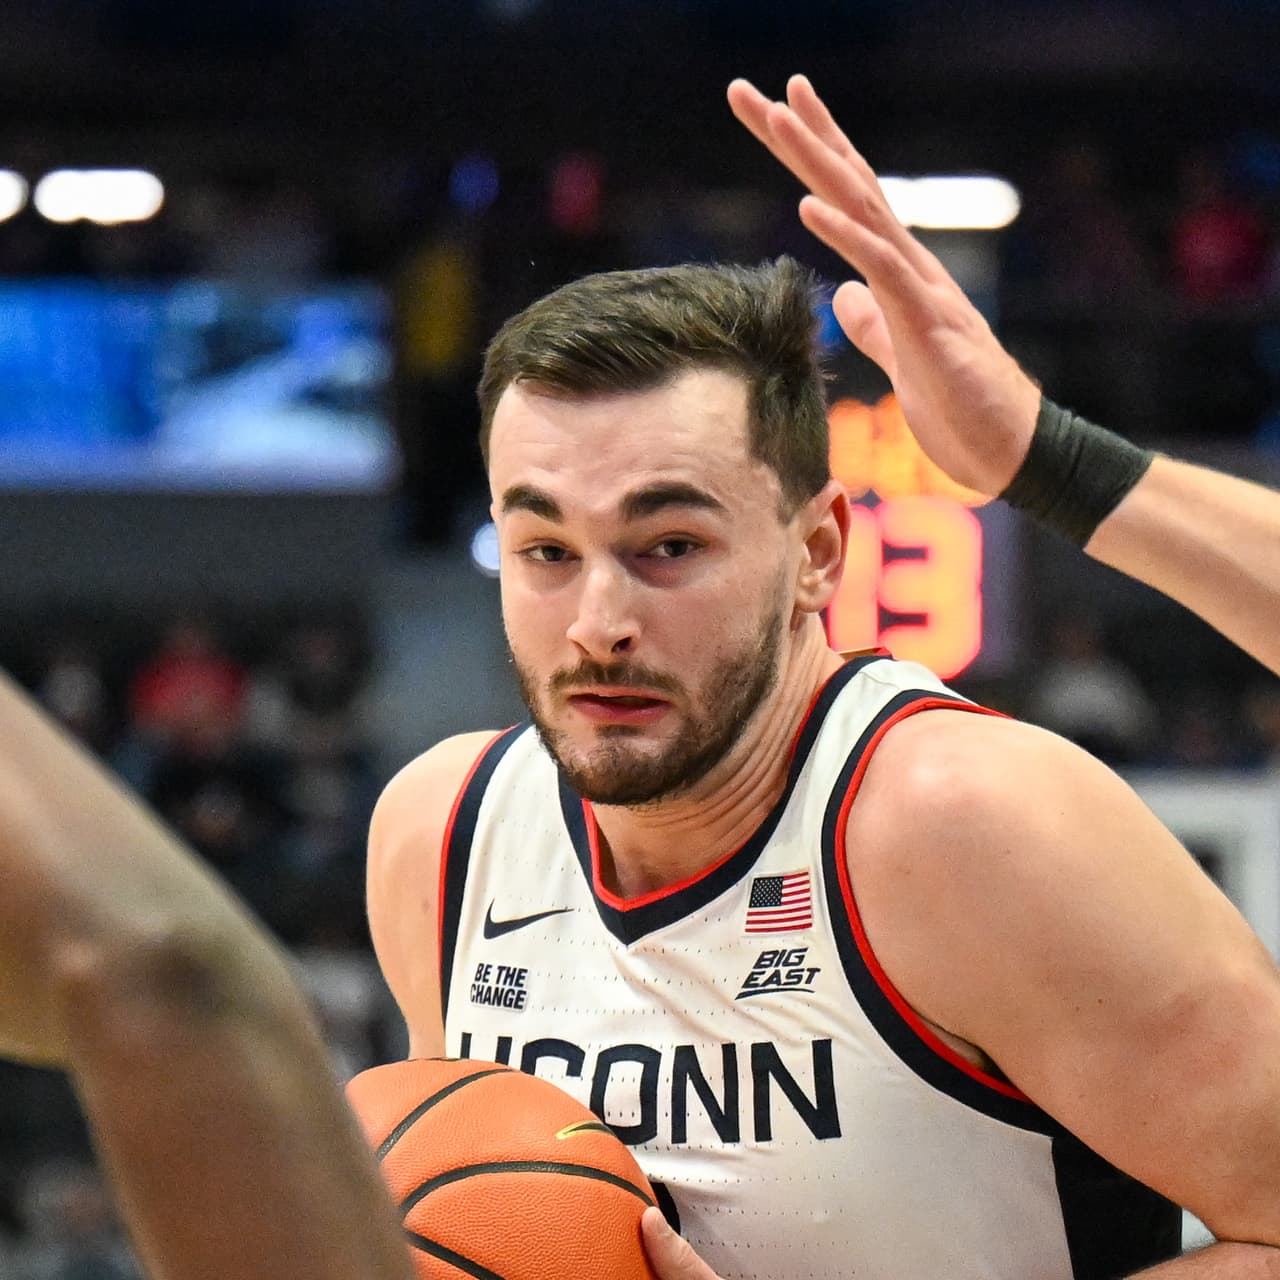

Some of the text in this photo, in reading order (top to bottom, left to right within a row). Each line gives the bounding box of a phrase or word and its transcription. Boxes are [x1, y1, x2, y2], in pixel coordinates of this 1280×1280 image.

[752, 947, 809, 969] BIG
[474, 963, 528, 988] BE THE
[741, 968, 821, 989] EAST
[470, 983, 527, 1010] CHANGE
